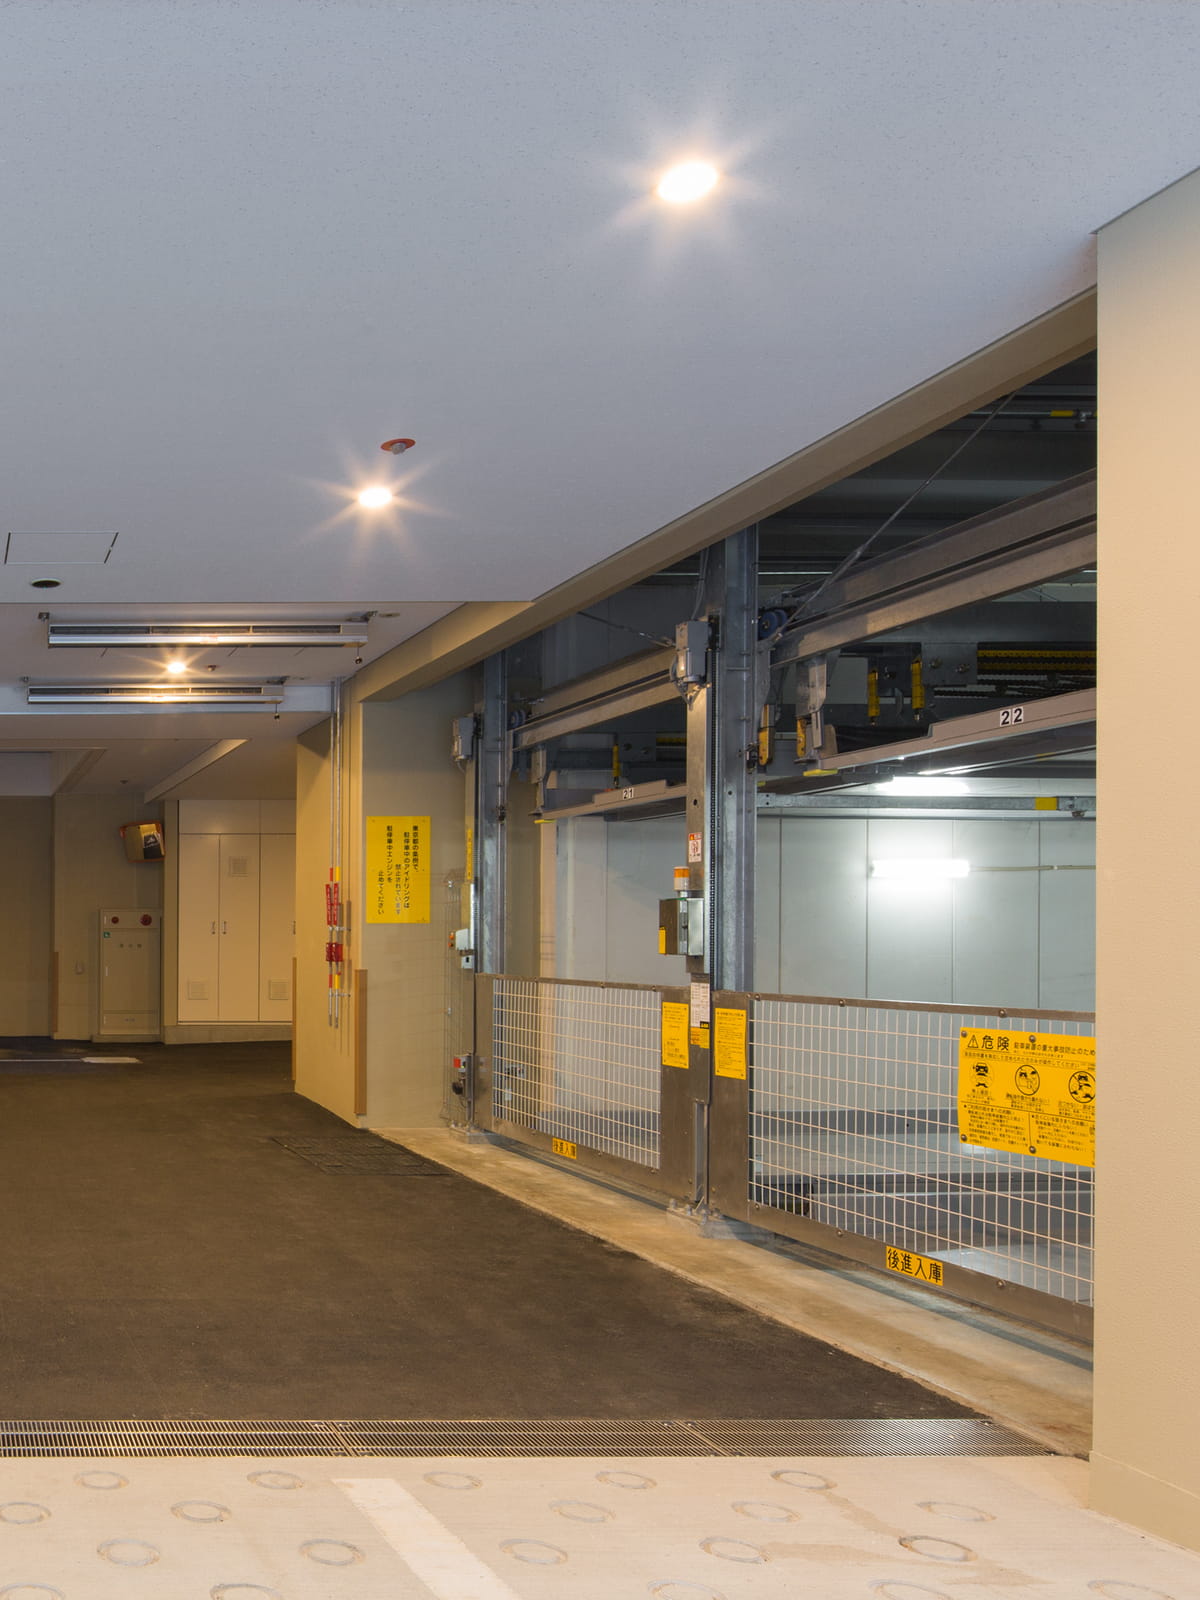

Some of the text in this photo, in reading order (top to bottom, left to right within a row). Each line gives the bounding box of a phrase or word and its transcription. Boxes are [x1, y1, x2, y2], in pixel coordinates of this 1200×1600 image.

[1001, 707, 1023, 726] 22
[623, 788, 633, 800] 21
[981, 1034, 1010, 1051] 危険
[887, 1247, 942, 1284] 後進入庫
